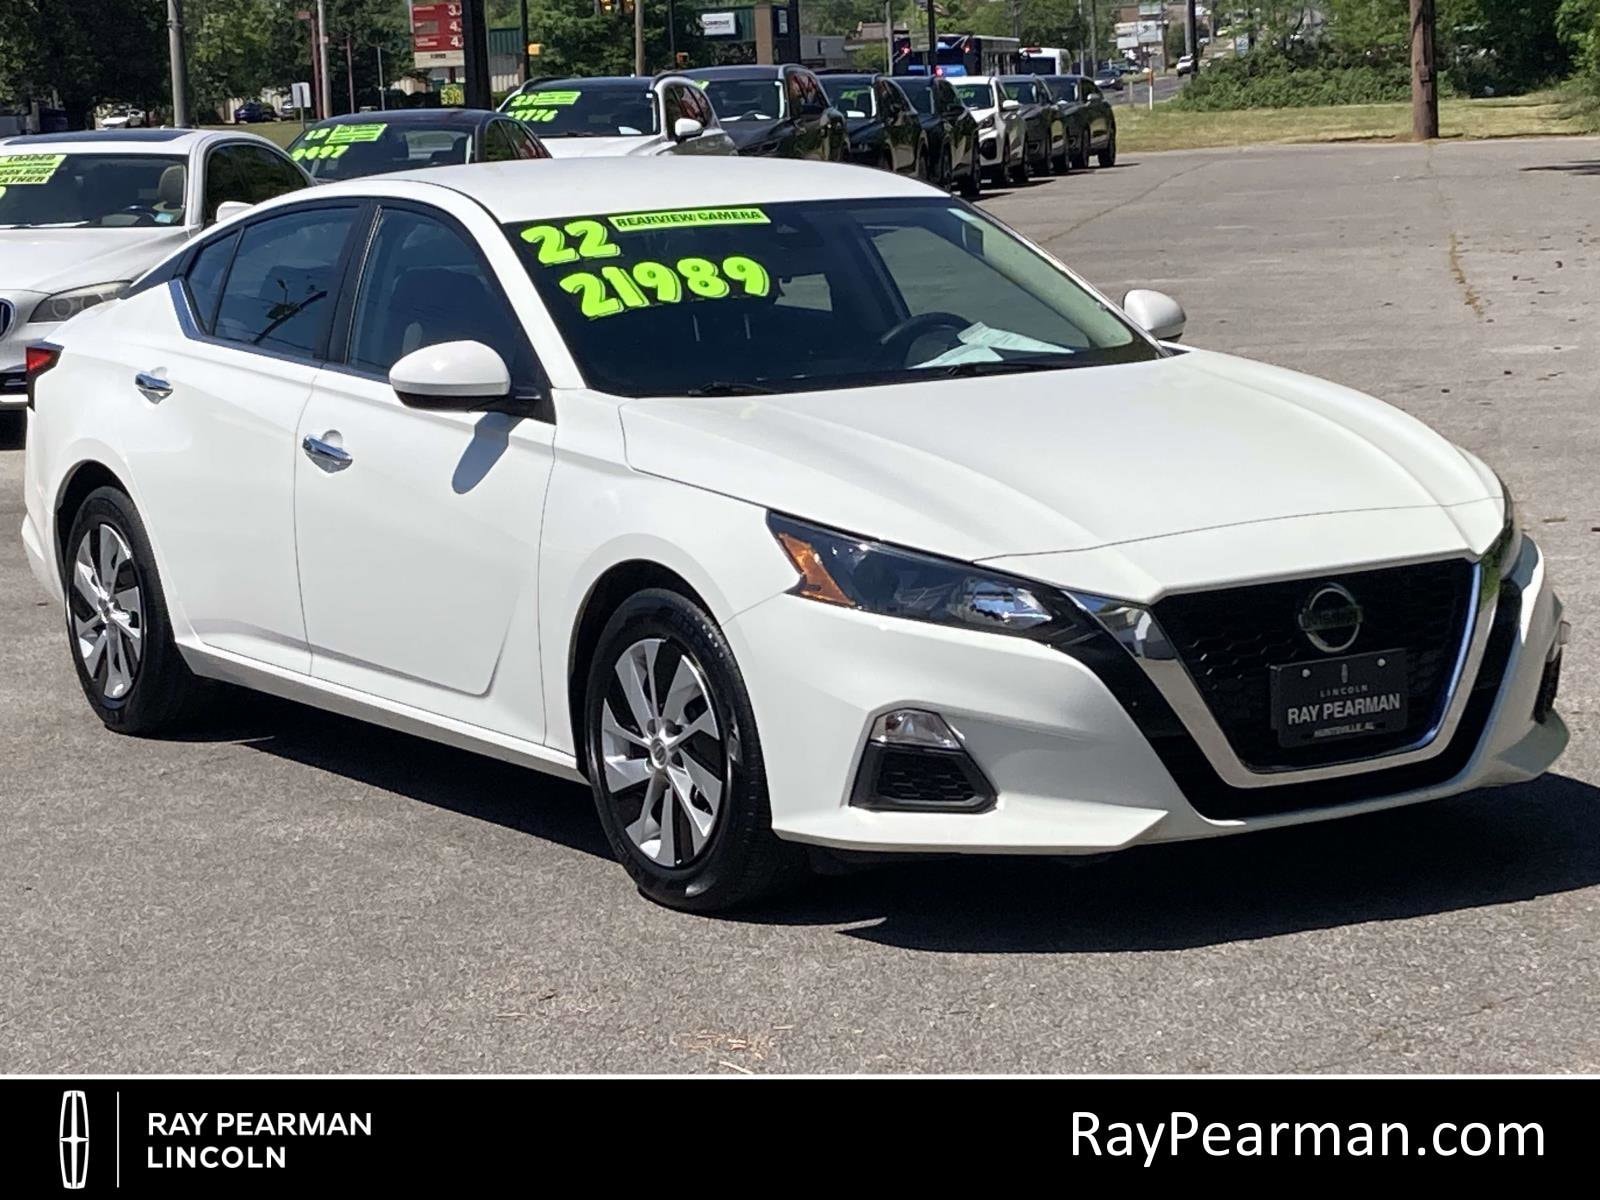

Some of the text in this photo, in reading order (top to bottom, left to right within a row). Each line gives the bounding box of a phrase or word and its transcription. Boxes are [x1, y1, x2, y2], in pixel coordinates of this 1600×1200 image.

[616, 210, 762, 227] REARVIEW CAMERA
[521, 220, 621, 267] 22
[559, 256, 770, 320] 21989
[1320, 684, 1369, 698] LINCOLN
[1288, 693, 1401, 725] RAY PEARMAN
